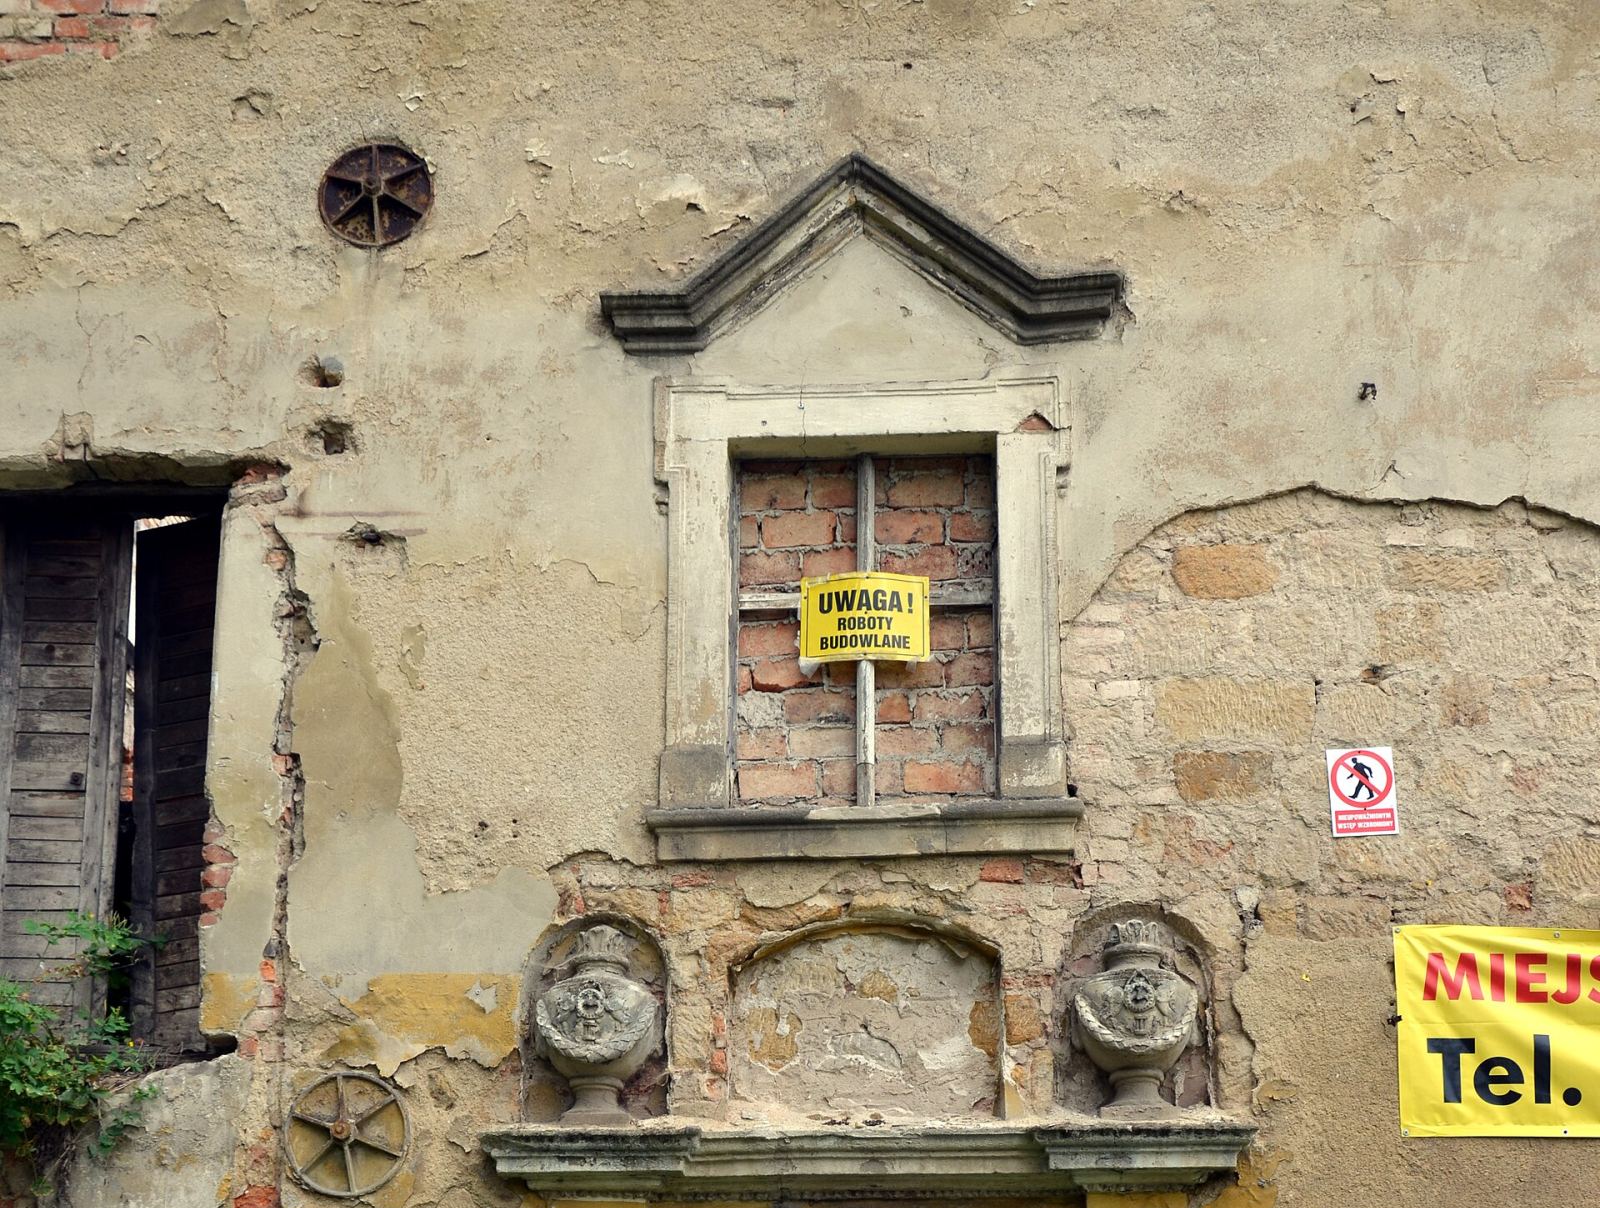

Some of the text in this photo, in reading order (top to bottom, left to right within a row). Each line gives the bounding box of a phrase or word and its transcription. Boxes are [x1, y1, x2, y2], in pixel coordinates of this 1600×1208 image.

[837, 616, 894, 631] ROBOTY
[819, 634, 911, 650] BUDOWLANE
[1426, 1033, 1582, 1106] Tel.
